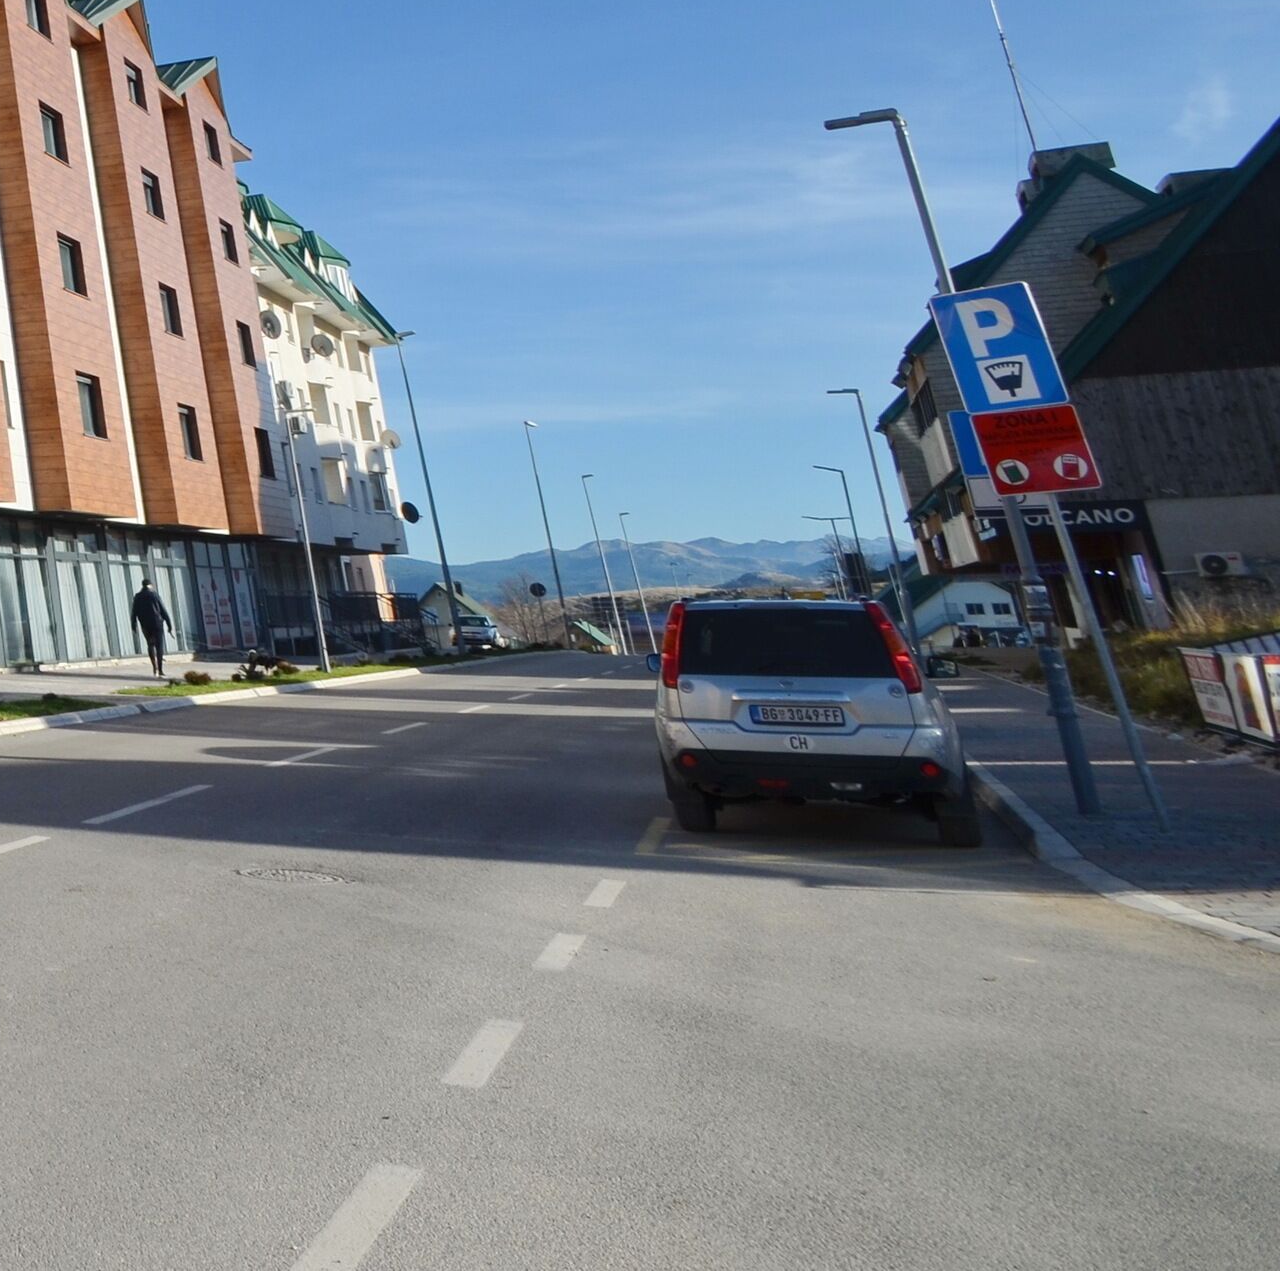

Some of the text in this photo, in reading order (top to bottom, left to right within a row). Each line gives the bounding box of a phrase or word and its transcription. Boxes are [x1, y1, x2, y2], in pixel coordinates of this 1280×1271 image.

[955, 297, 1015, 359] P
[993, 411, 1048, 429] ZONA
[1023, 508, 1135, 526] OLCANO
[761, 707, 778, 720] BG
[789, 735, 809, 750] CH
